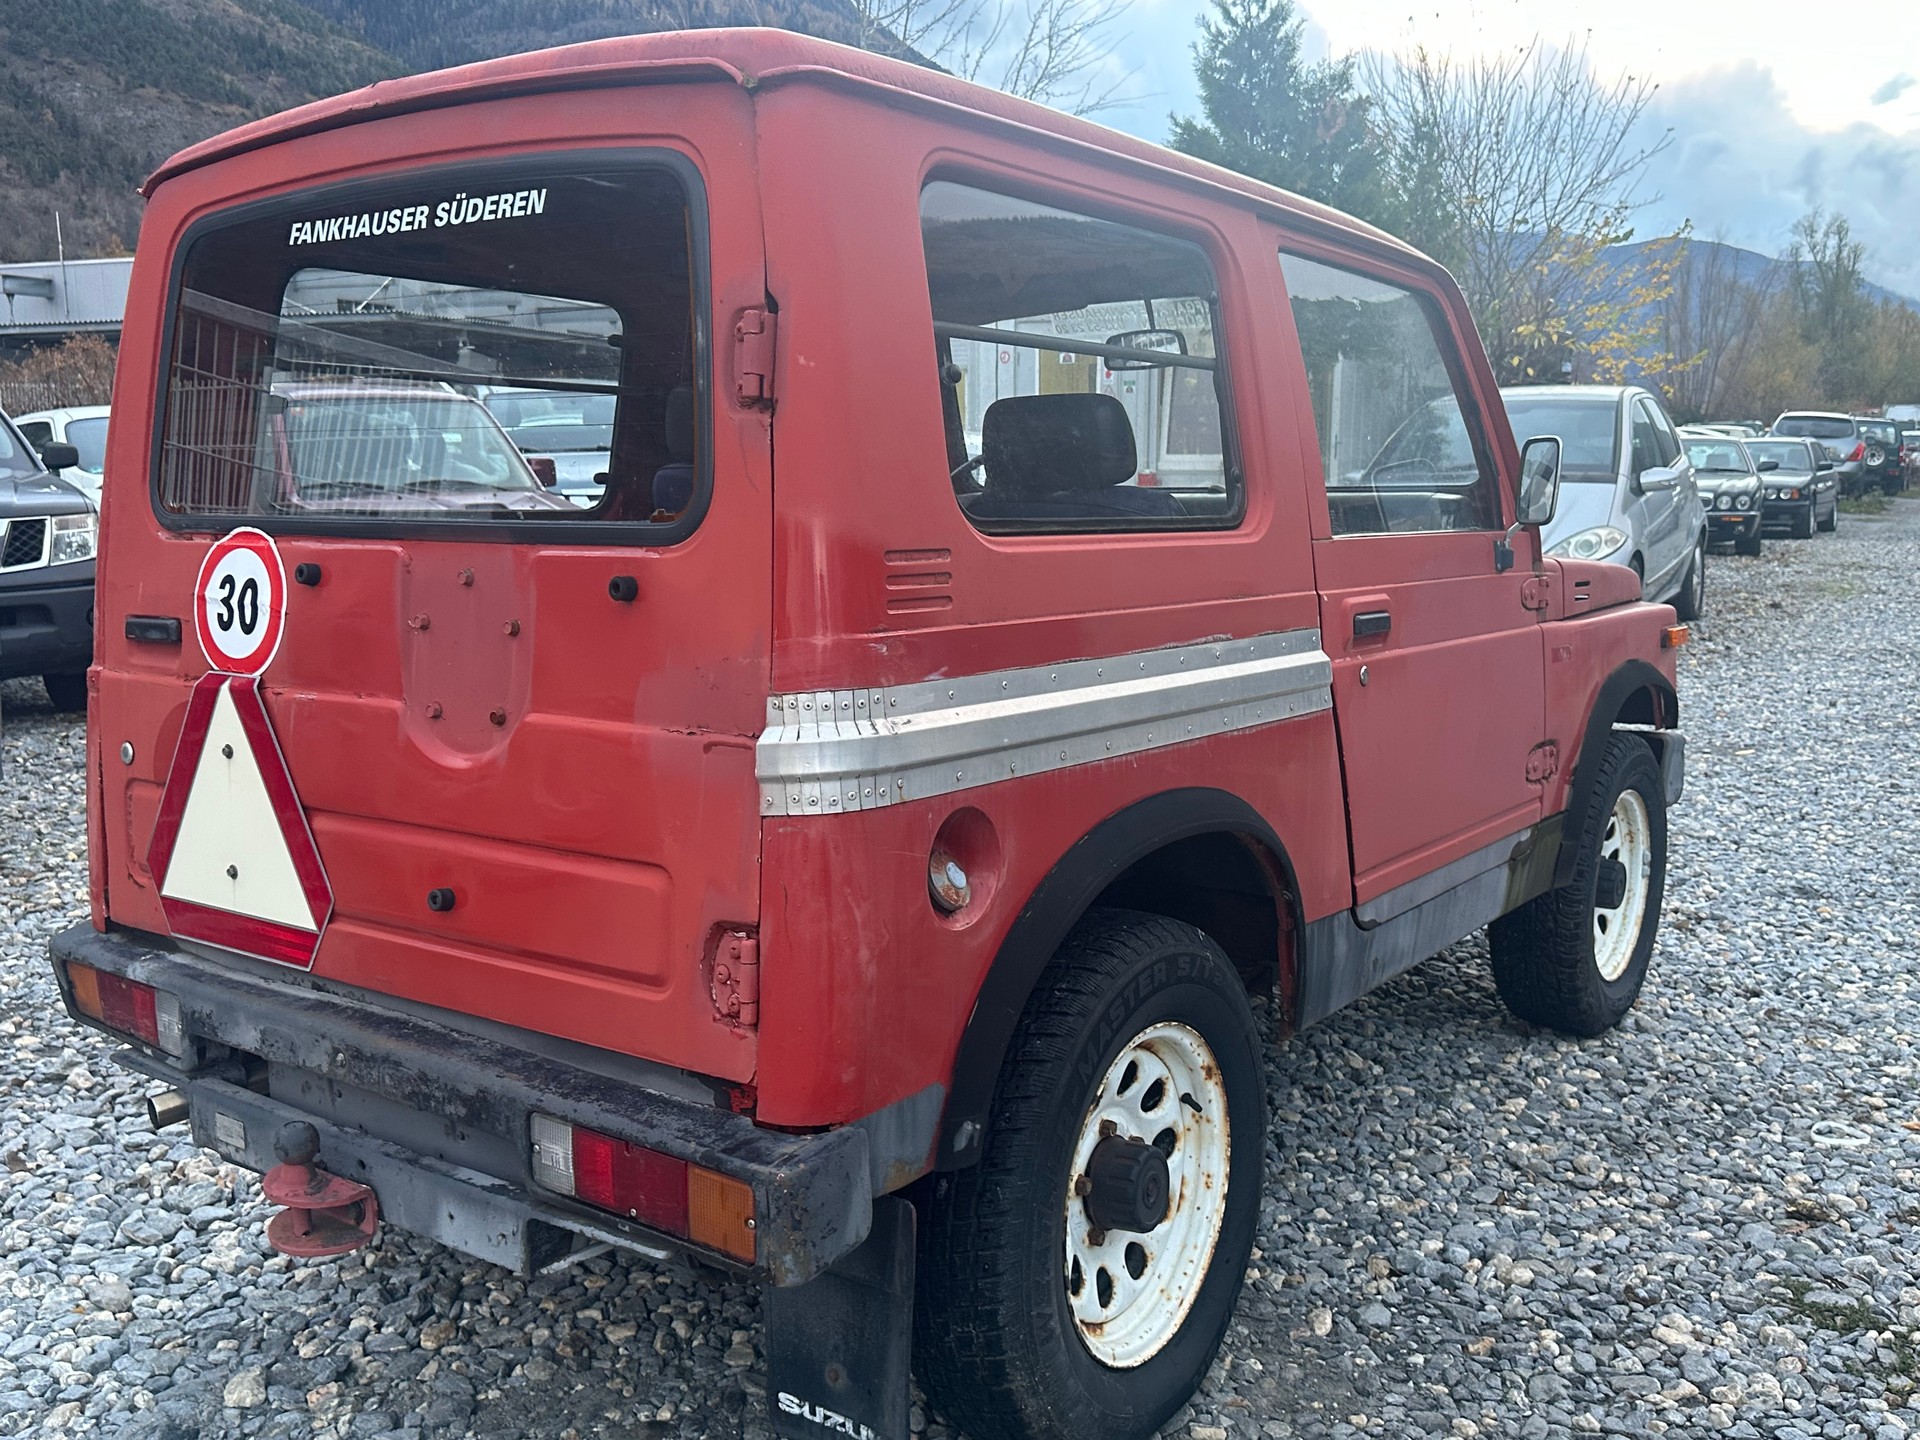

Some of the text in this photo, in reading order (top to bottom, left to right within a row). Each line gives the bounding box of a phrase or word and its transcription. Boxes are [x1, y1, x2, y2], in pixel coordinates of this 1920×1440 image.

[289, 188, 548, 246] FANKHAUSER SÜDEREN
[217, 573, 259, 636] 30
[777, 1391, 881, 1440] SUZU
